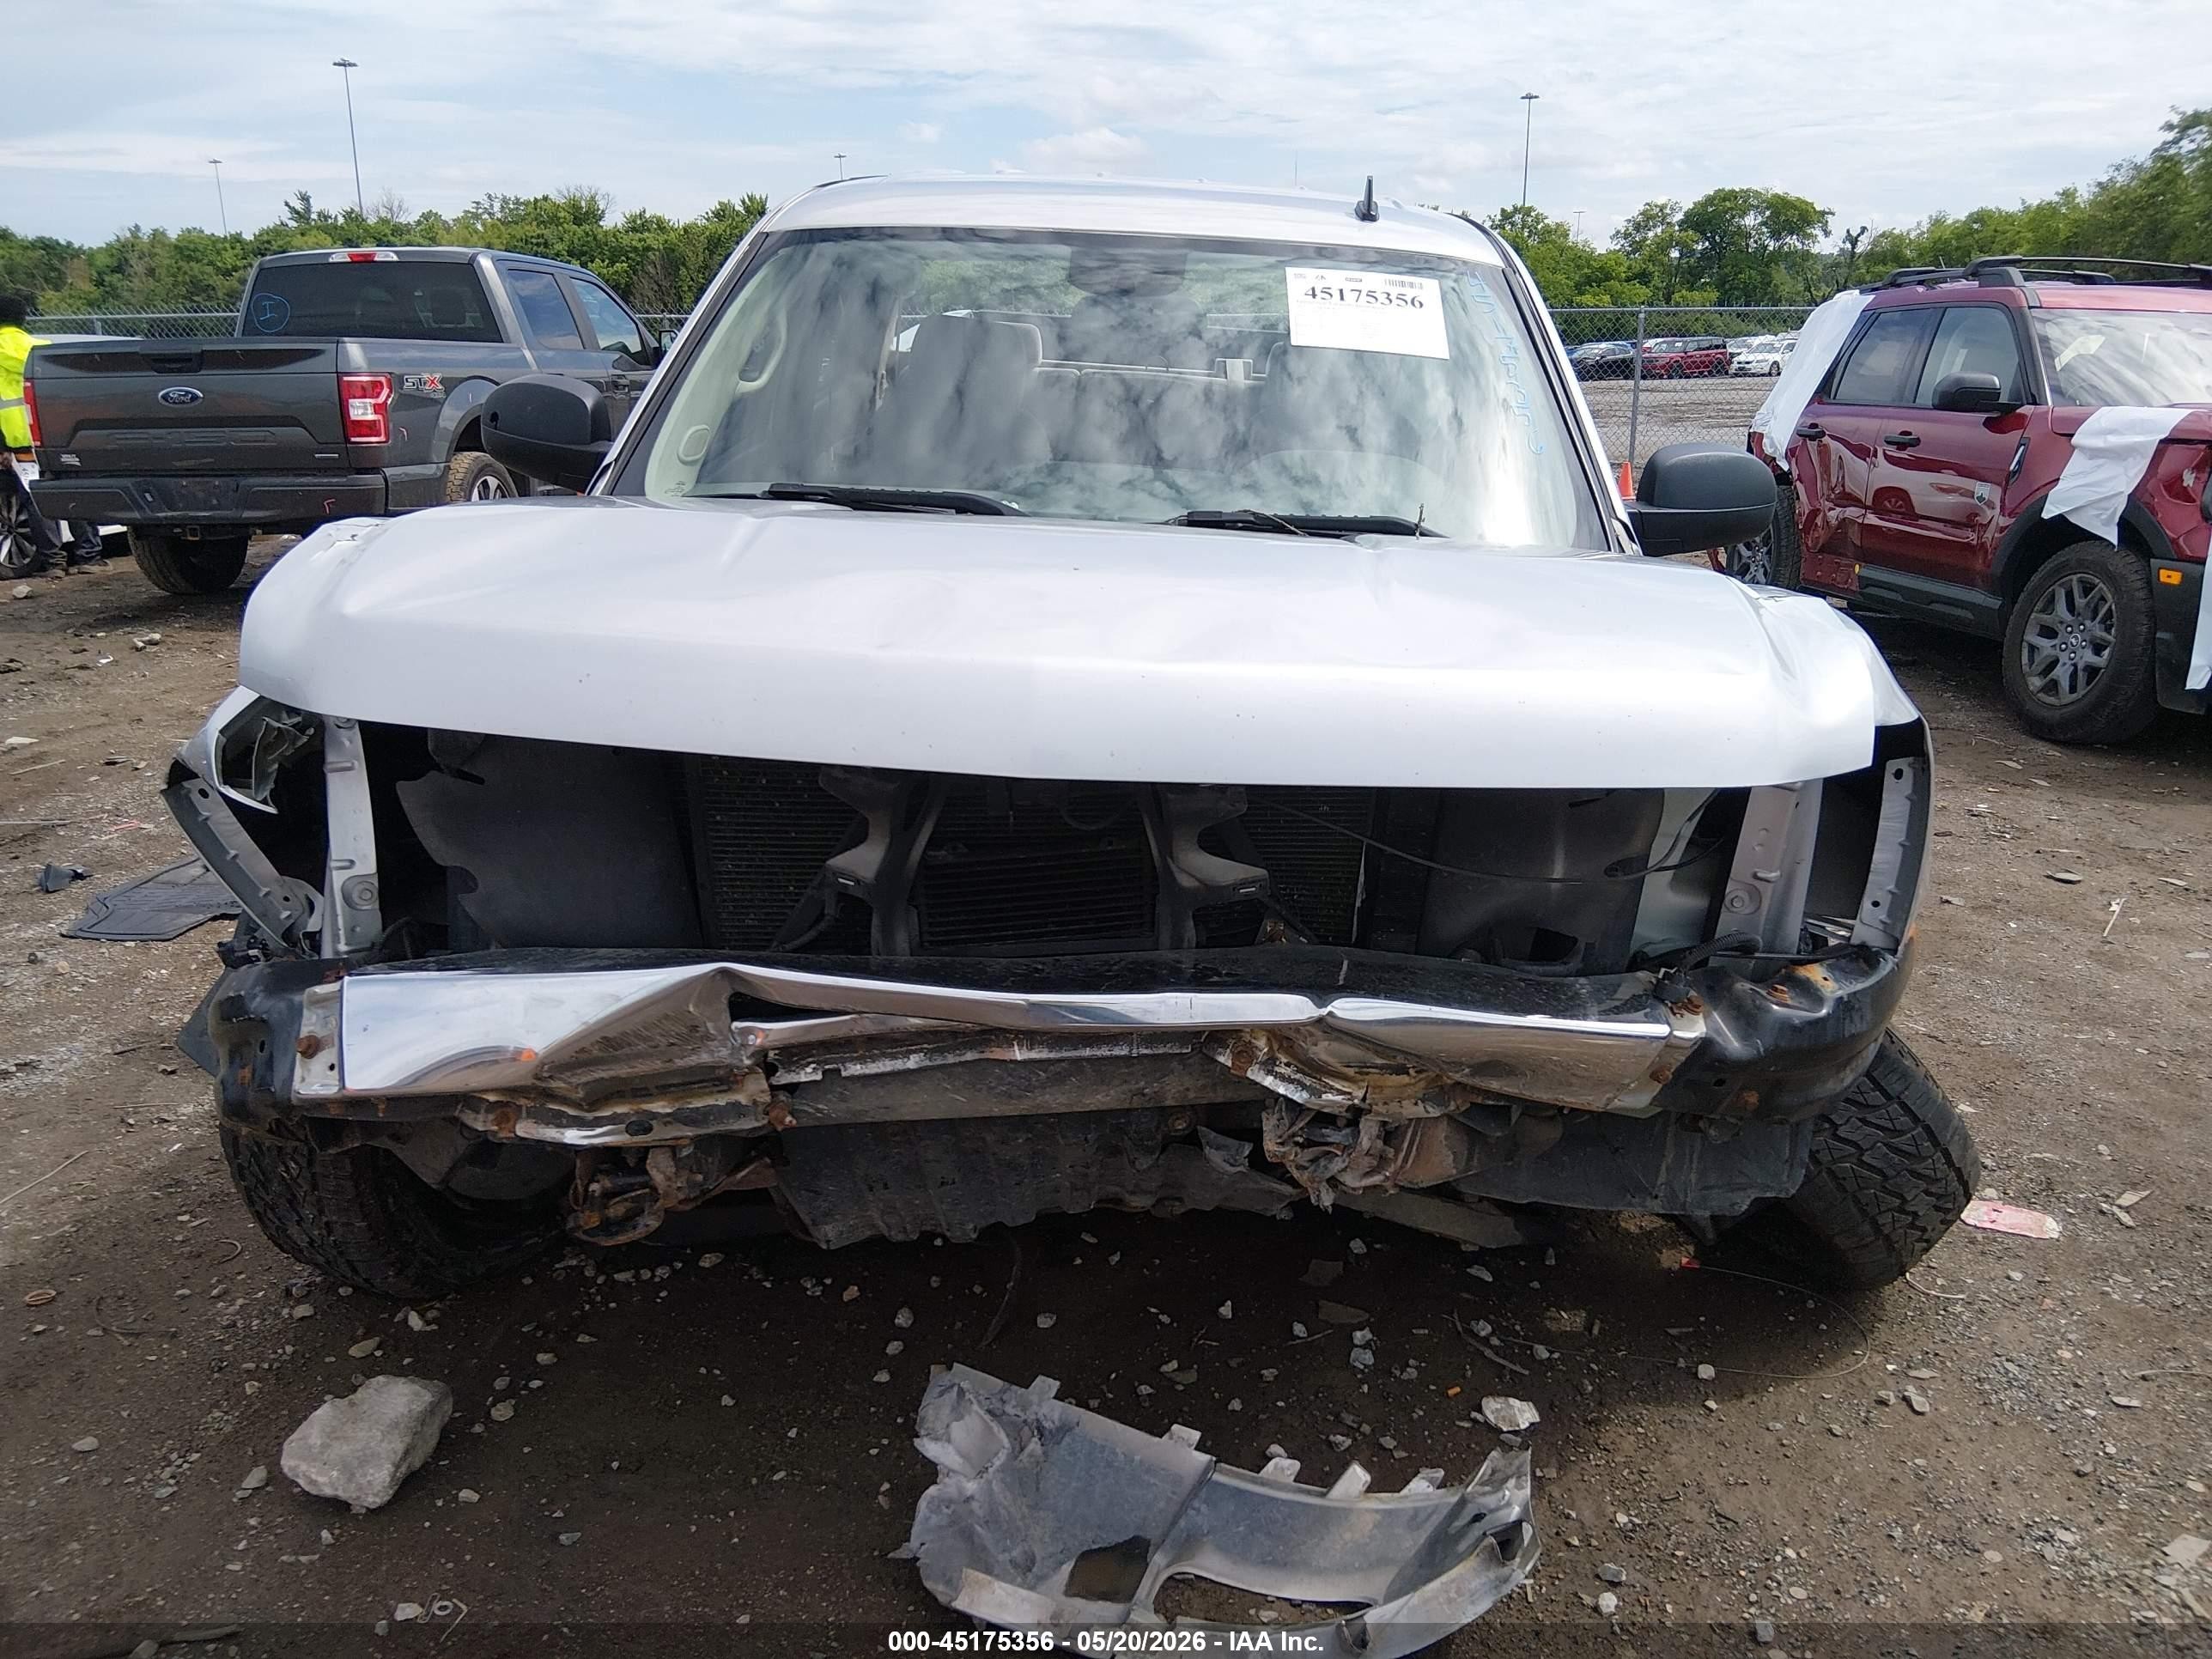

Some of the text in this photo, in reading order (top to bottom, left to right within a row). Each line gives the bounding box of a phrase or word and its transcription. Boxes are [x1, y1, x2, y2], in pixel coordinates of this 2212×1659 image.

[1304, 286, 1425, 309] 45175356
[404, 373, 445, 392] STX
[167, 391, 192, 403] Ford
